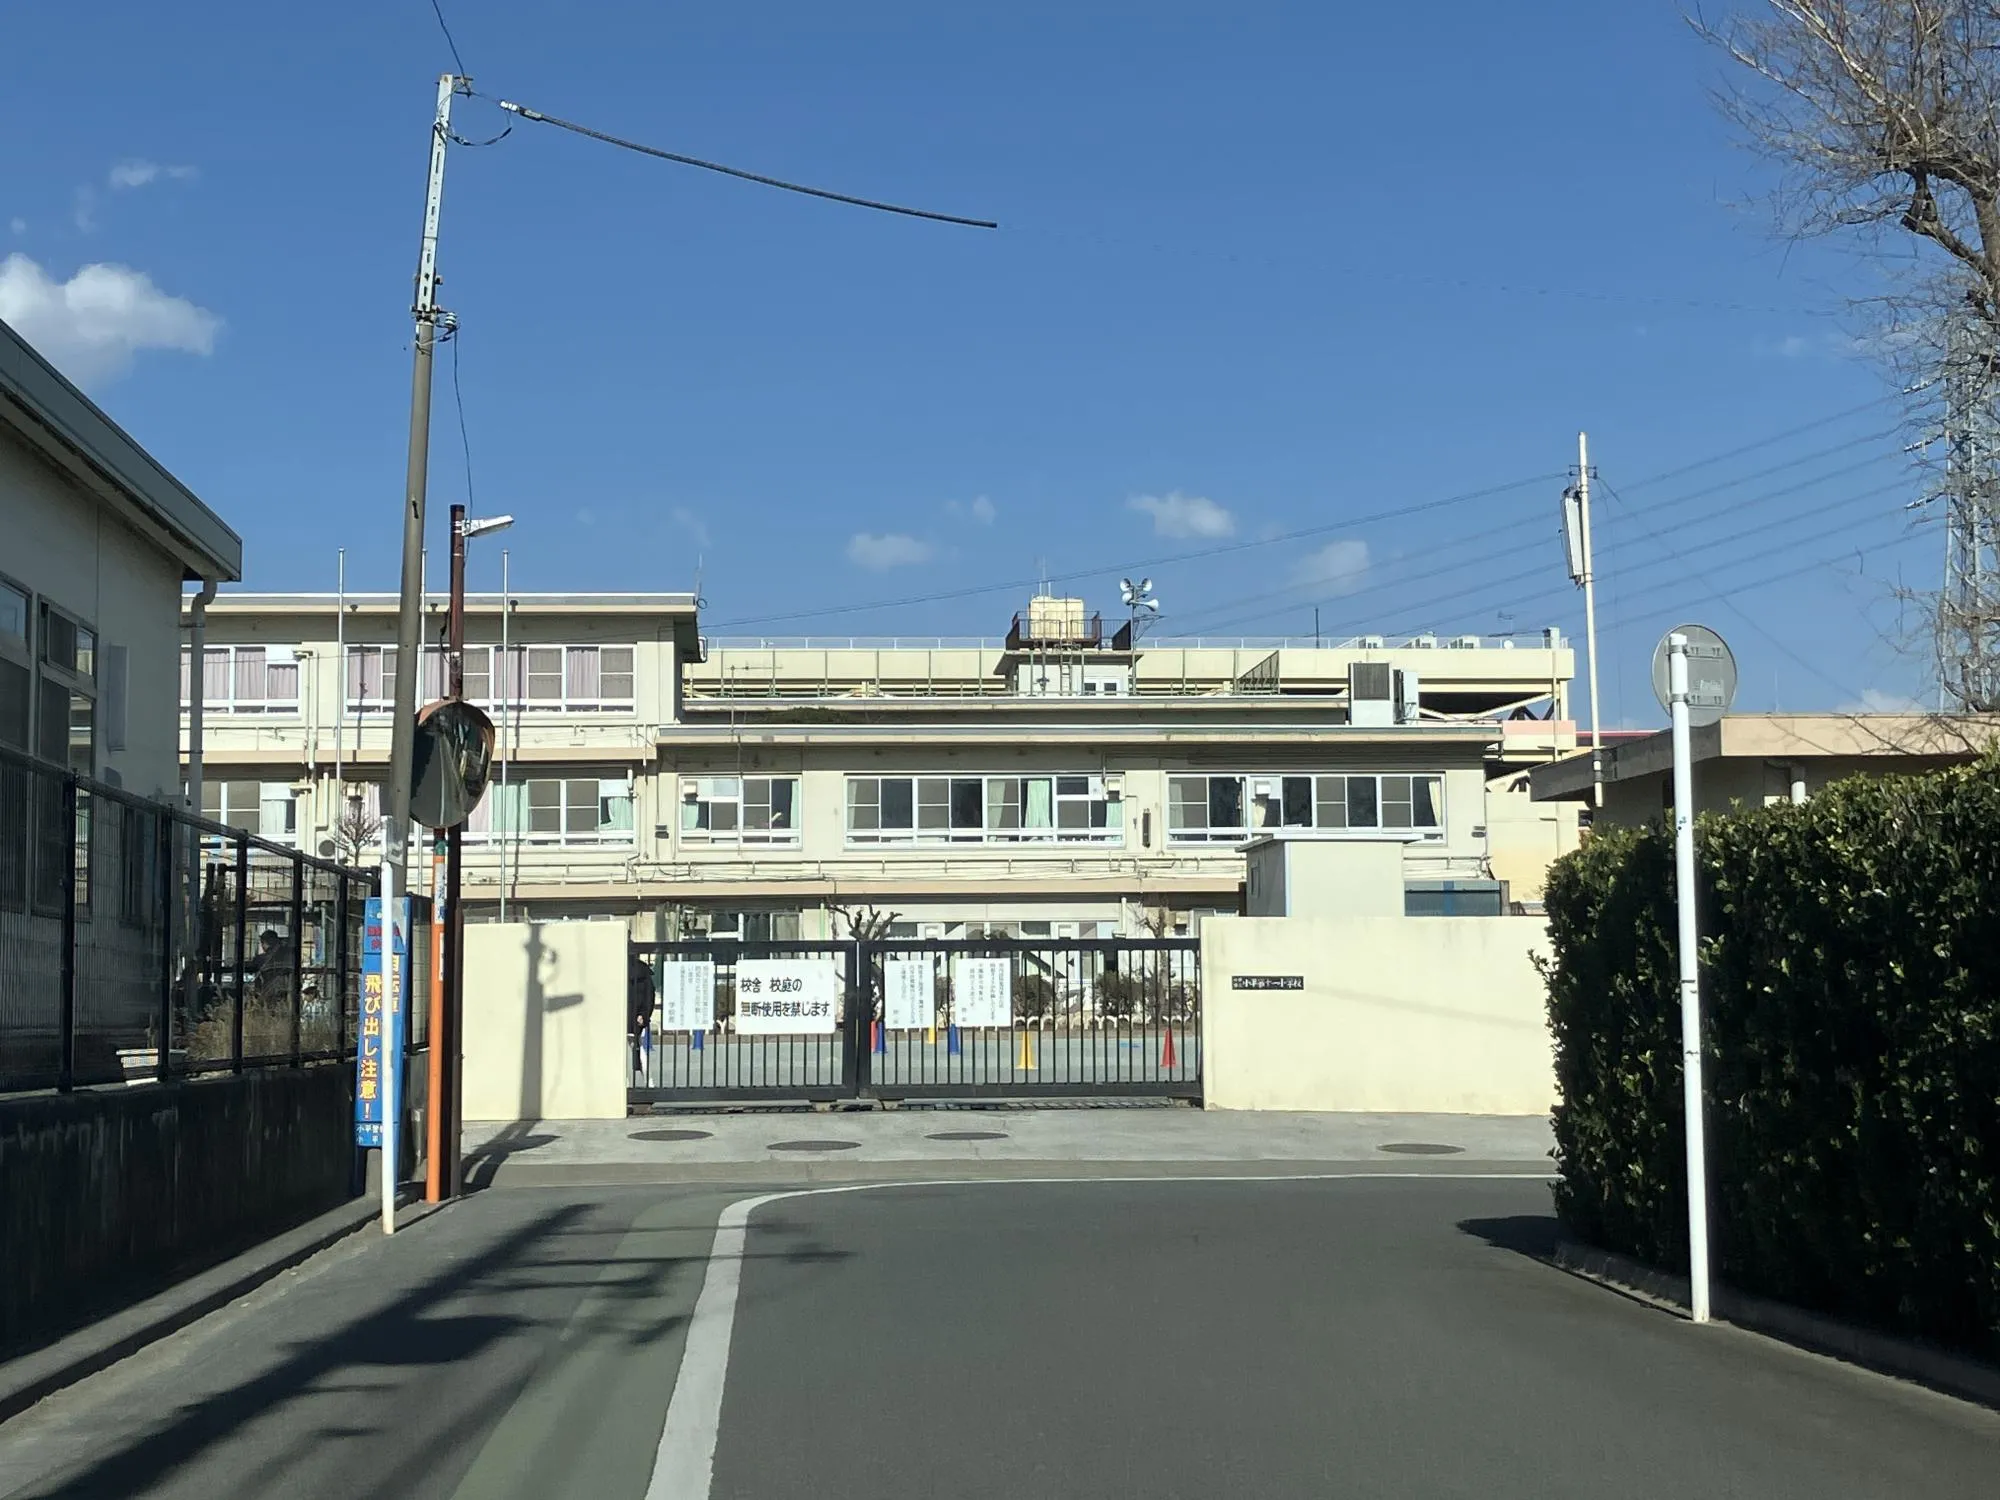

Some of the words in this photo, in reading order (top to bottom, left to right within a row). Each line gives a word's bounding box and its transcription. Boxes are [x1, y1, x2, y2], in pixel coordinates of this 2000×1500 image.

[740, 977, 762, 993] 校舎
[769, 977, 803, 992] 校庭の
